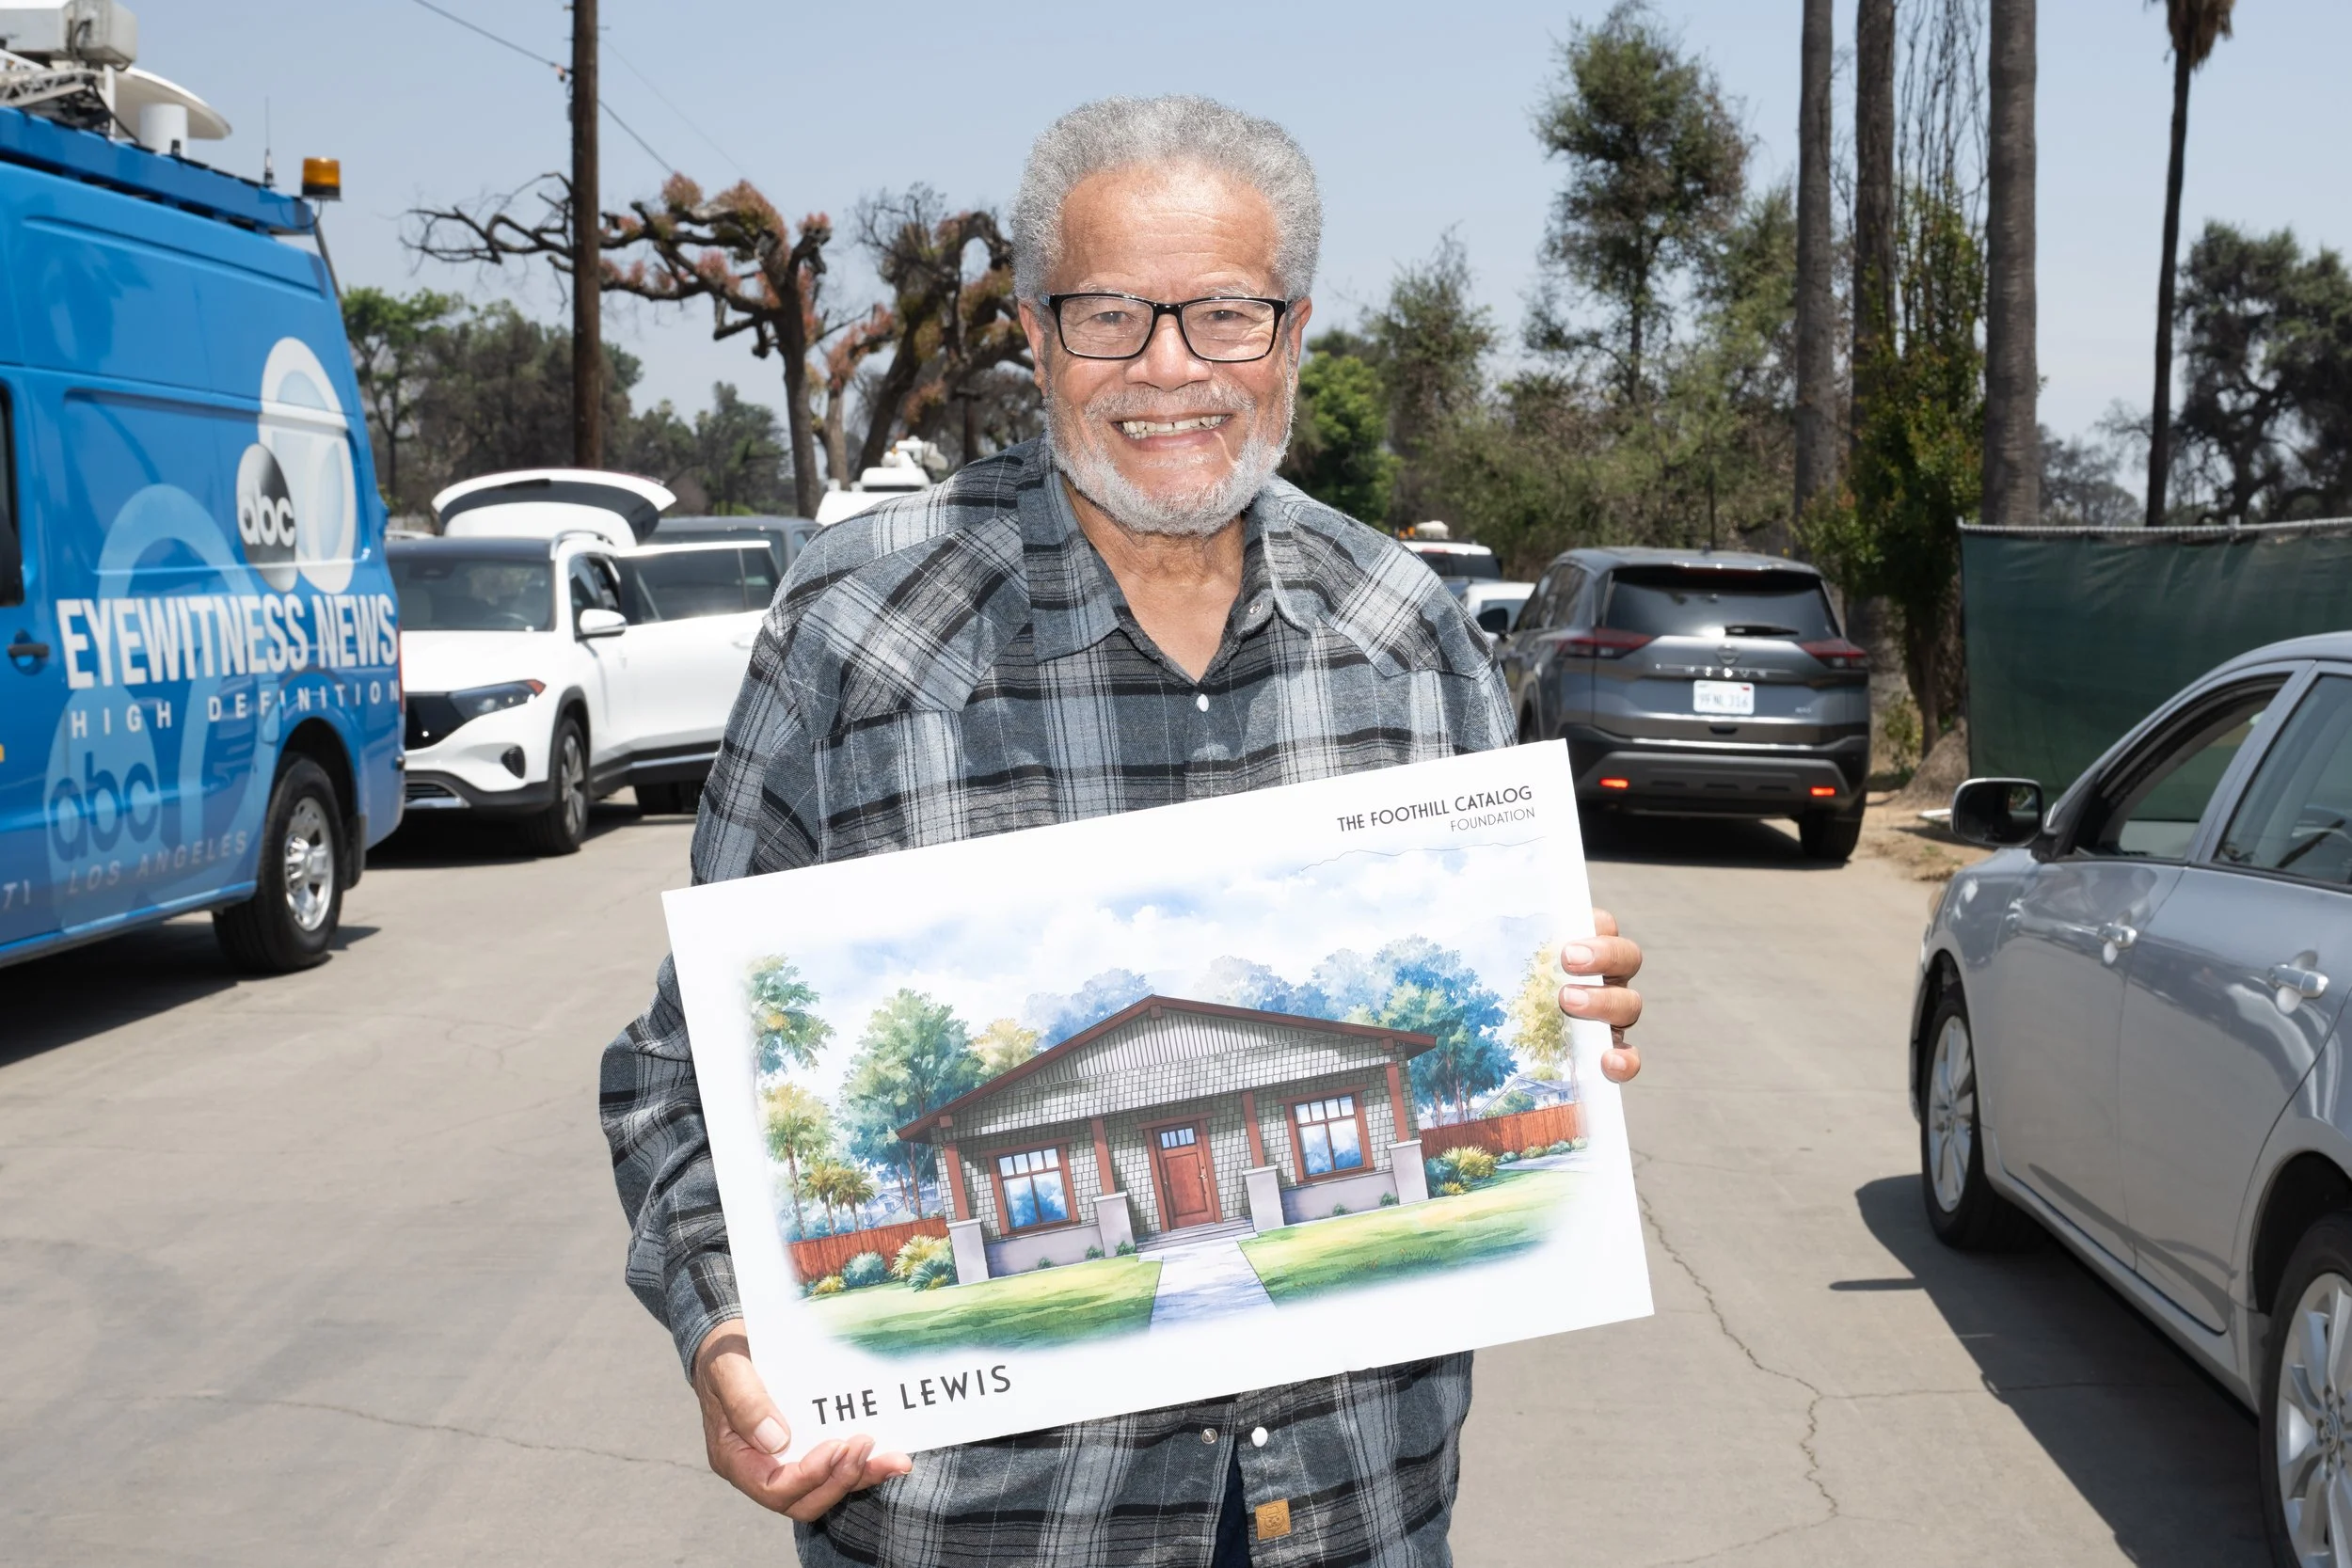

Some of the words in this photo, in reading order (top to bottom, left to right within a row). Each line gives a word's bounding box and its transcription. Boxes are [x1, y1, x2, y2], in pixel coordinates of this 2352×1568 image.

[238, 478, 295, 548] abc
[56, 594, 309, 689] EYEWITNESS
[310, 594, 398, 669] NEWS
[72, 702, 172, 738] HIGH
[208, 680, 399, 721] DEFINITION
[49, 751, 157, 862] abc
[1337, 814, 1365, 832] THE
[1371, 800, 1450, 827] FOOTHILL
[1454, 785, 1533, 812] CATALOG
[1450, 807, 1535, 832] FOUNDATION
[67, 860, 120, 895] LOS
[136, 830, 247, 878] ANGELES
[812, 1389, 878, 1425] THE
[899, 1365, 1011, 1410] LEWIS
